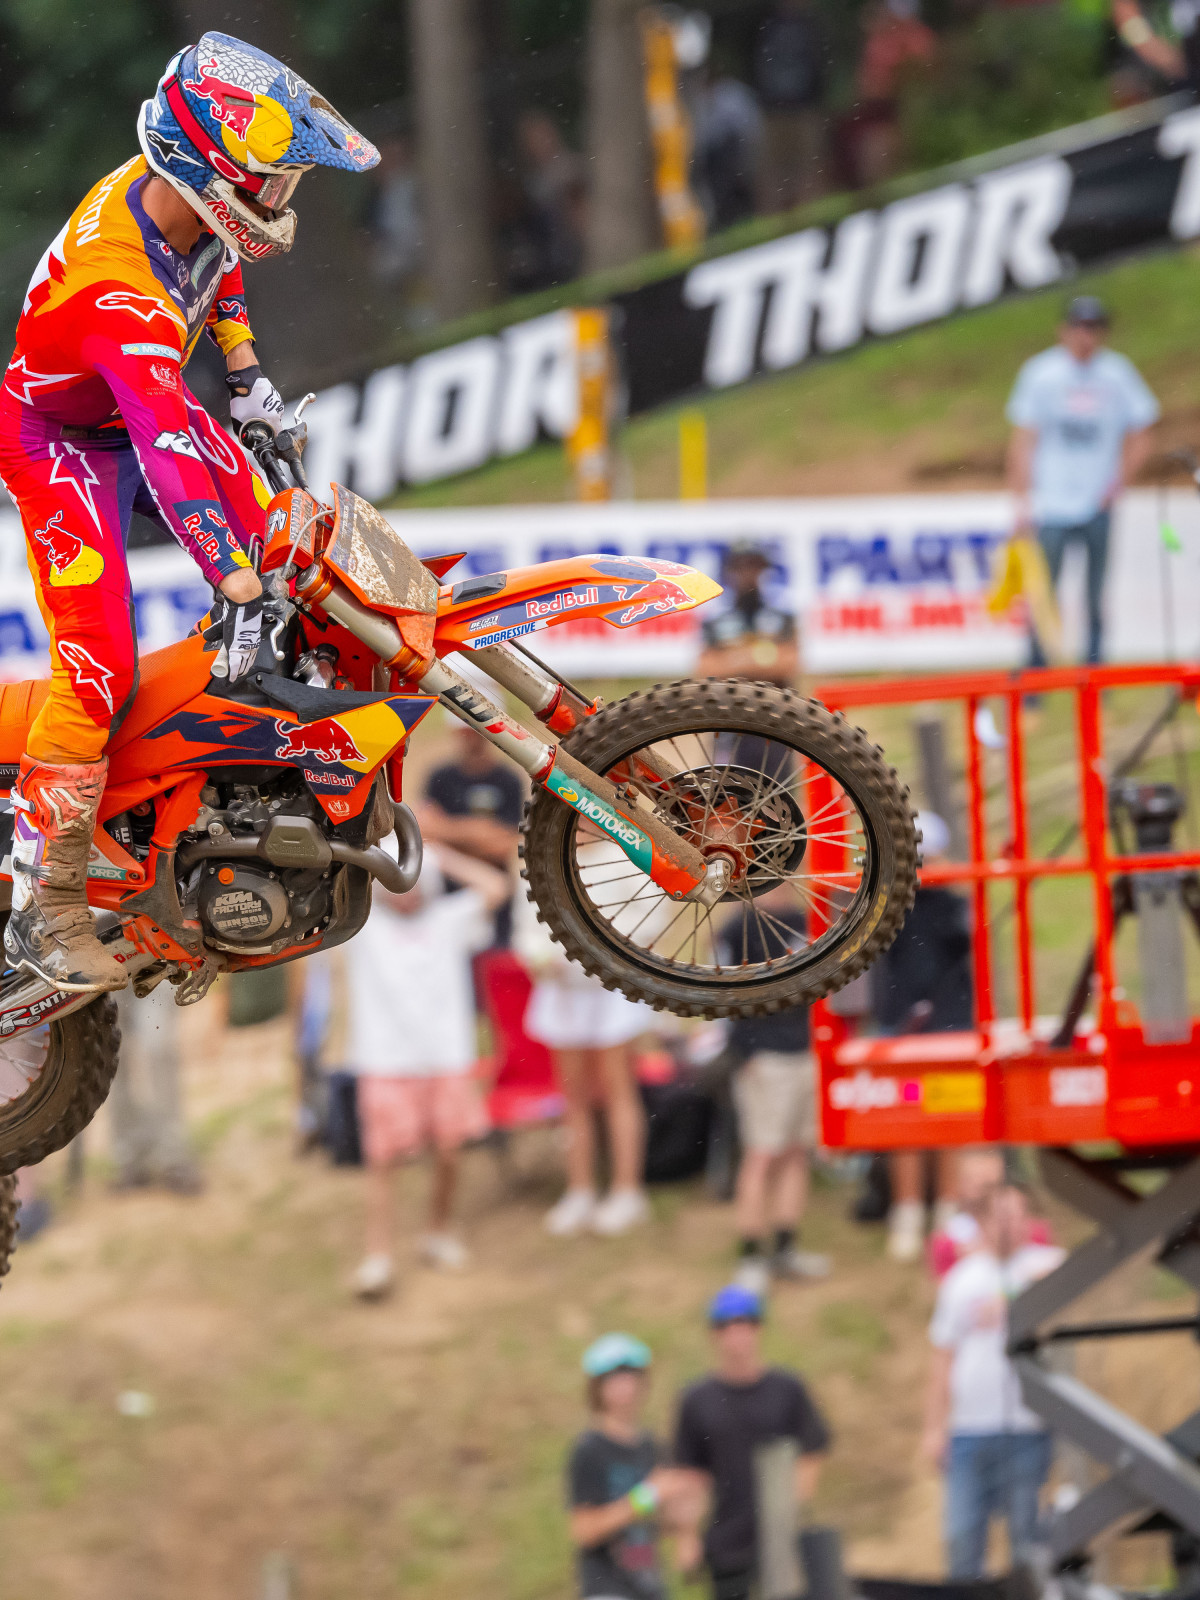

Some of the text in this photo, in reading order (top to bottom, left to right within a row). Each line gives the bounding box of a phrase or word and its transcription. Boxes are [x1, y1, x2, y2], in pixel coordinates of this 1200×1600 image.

[684, 157, 1074, 389] THOR
[290, 308, 577, 503] HOR
[474, 621, 536, 649] PROGRESSIVE
[575, 796, 647, 851] MOTOREX
[213, 900, 262, 915] FACTORY
[215, 891, 253, 907] KTM
